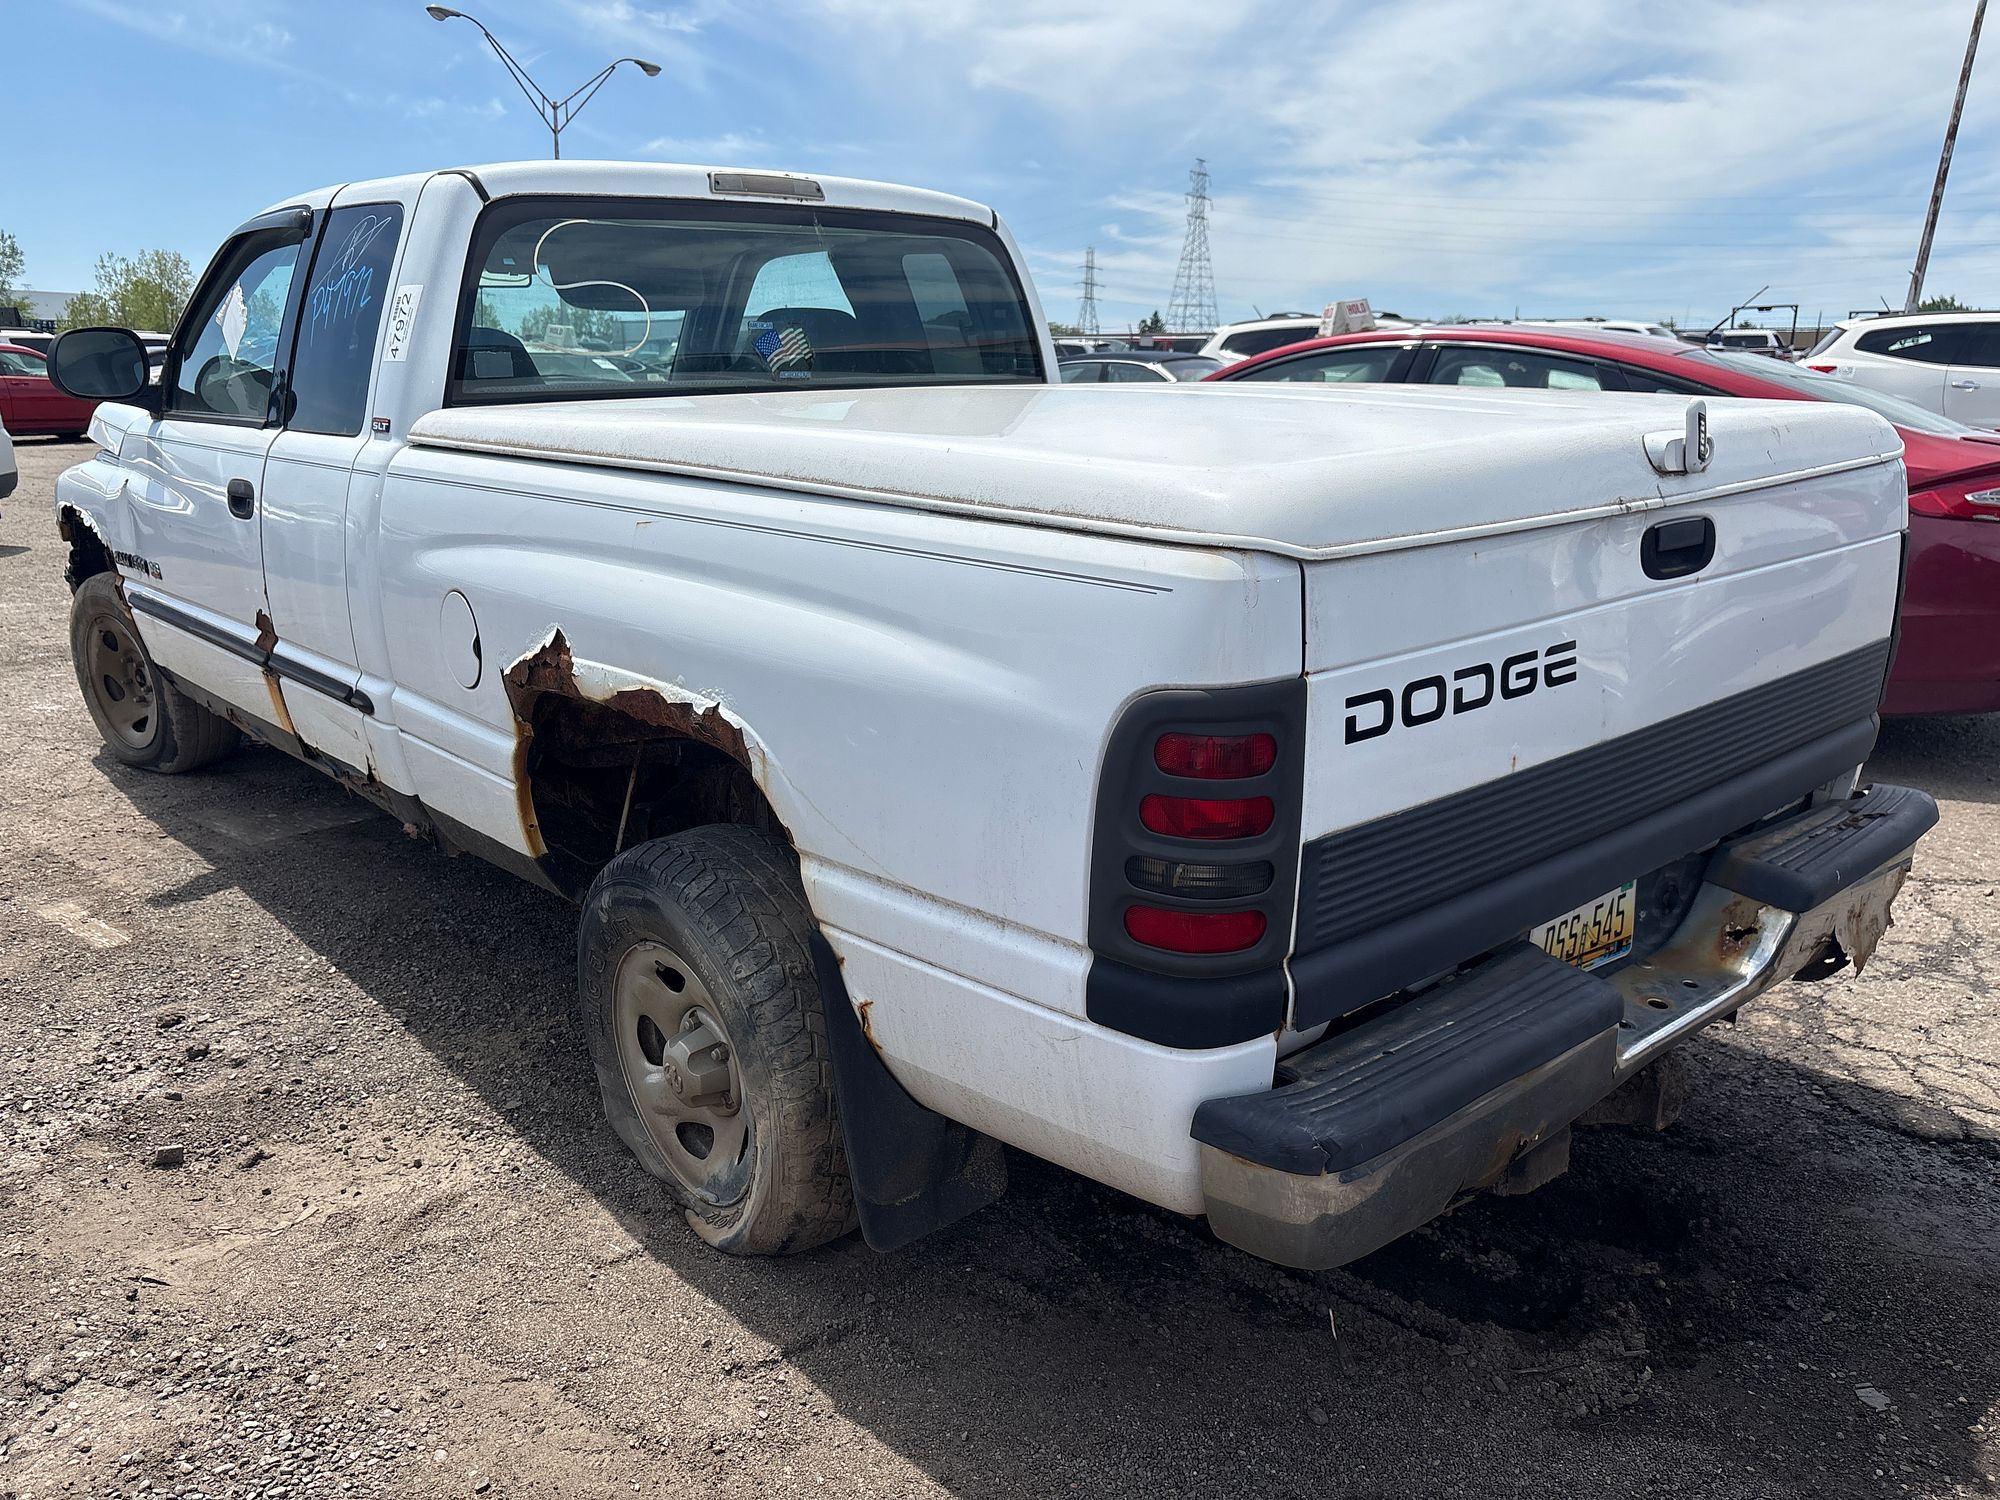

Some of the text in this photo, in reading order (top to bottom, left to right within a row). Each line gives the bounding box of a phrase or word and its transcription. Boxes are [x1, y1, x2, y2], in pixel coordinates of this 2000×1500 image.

[390, 293, 412, 359] 47972
[1347, 302, 1366, 315] HOLD
[372, 421, 389, 431] SLT
[1345, 640, 1577, 746] DODGE
[1590, 893, 1627, 948] 545
